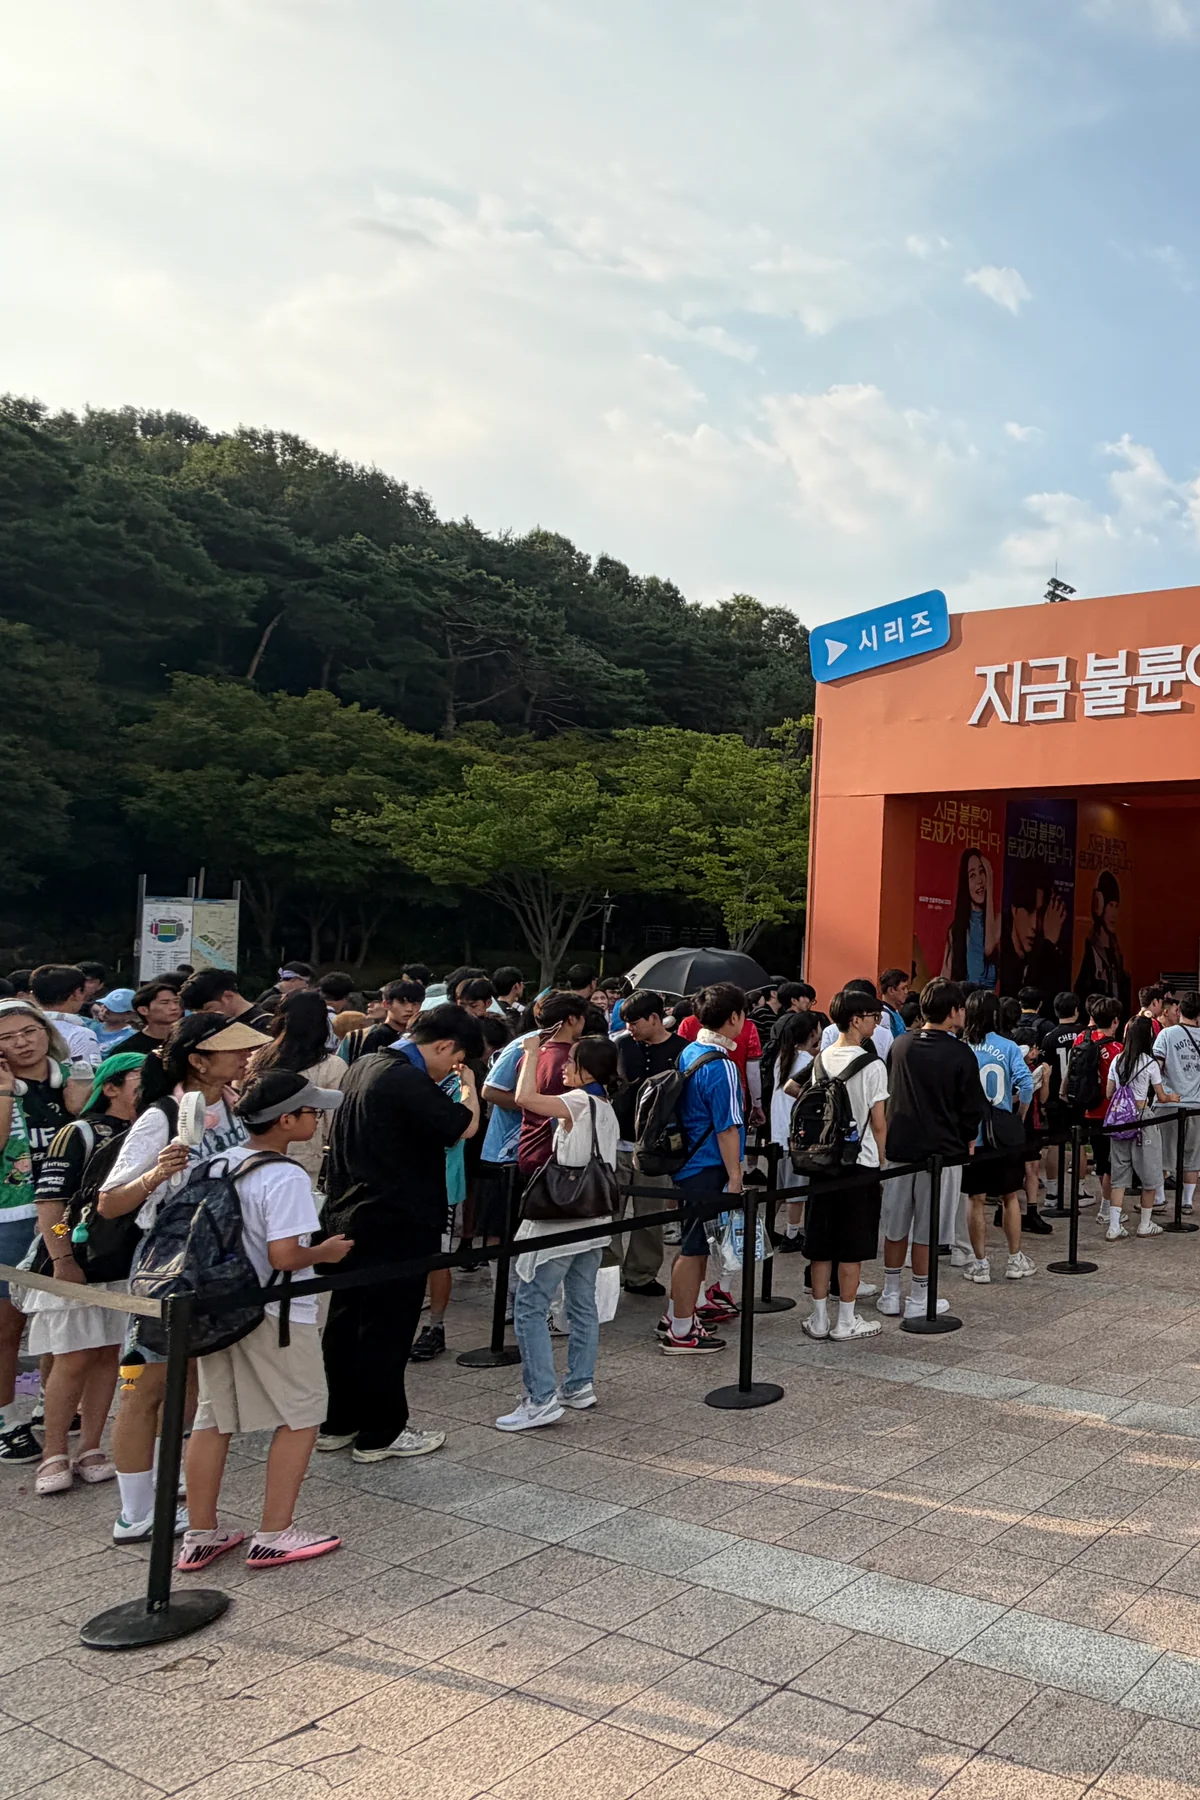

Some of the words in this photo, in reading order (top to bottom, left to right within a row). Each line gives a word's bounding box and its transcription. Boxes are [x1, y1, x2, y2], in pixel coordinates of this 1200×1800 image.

[859, 610, 932, 651] 시리즈
[967, 656, 1071, 725] 지금
[959, 803, 992, 829] 불륜이
[1018, 817, 1039, 839] 지금
[920, 817, 956, 845] 문제가
[957, 826, 1001, 854] 아닙니다
[1007, 836, 1036, 861] 문제가
[1057, 1033, 1077, 1044] CHER
[973, 1043, 1005, 1061] NARDO
[980, 1063, 1006, 1106] 0
